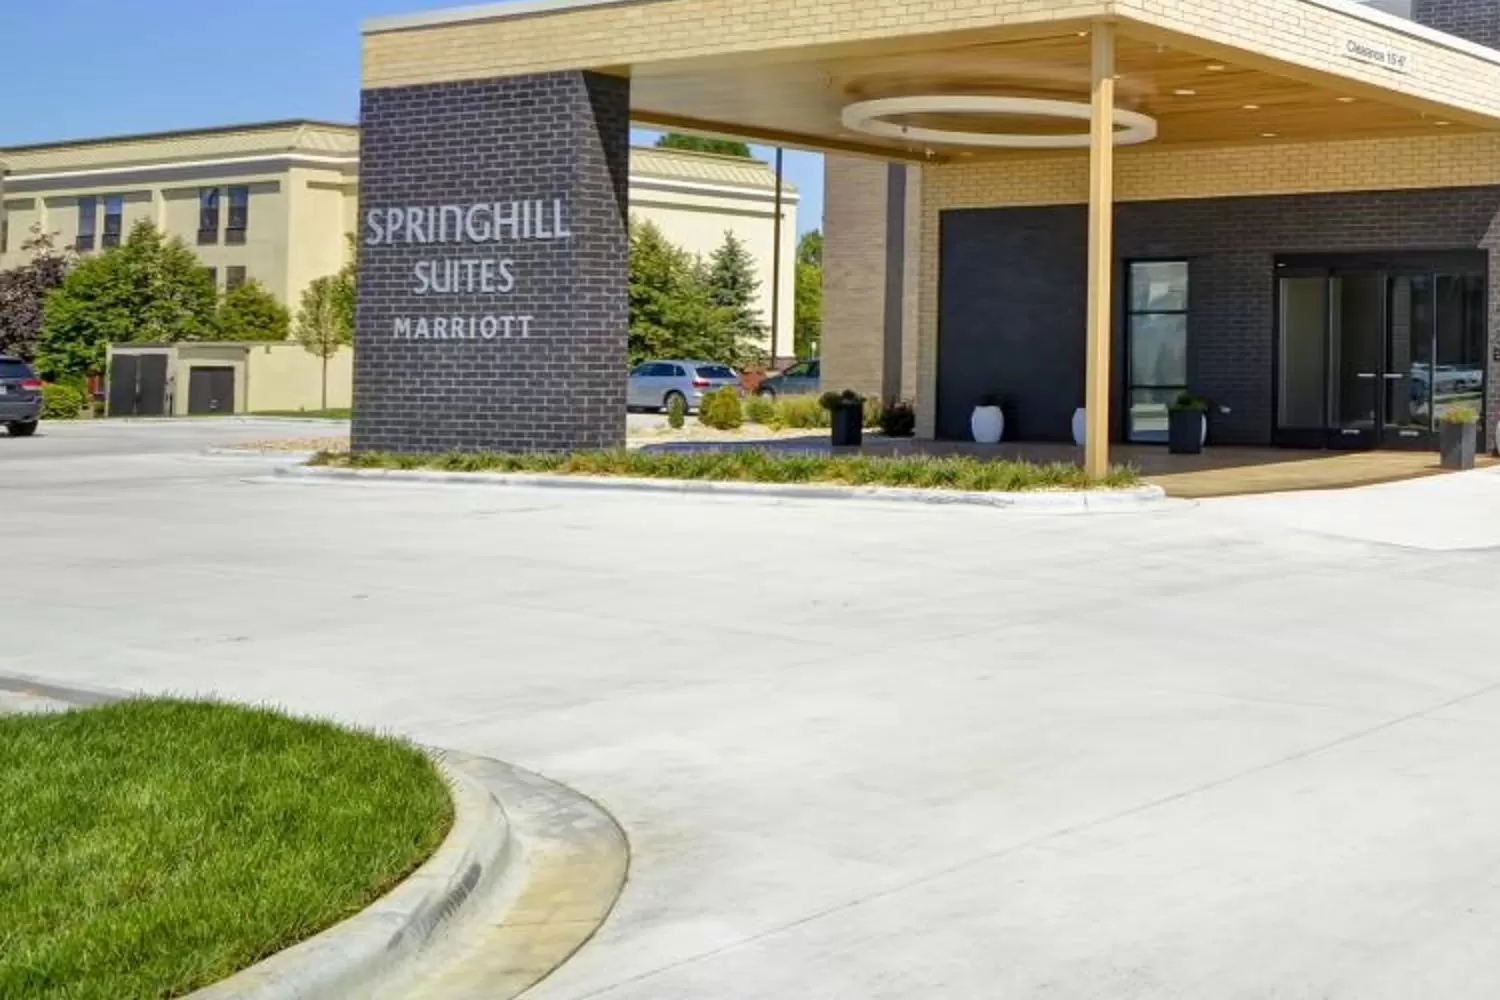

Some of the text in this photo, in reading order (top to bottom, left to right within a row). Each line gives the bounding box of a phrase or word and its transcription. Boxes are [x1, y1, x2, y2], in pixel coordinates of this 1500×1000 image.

[365, 199, 572, 245] SPRINGHILL
[413, 258, 514, 295] SUITES
[392, 315, 534, 339] MARRIOTT
